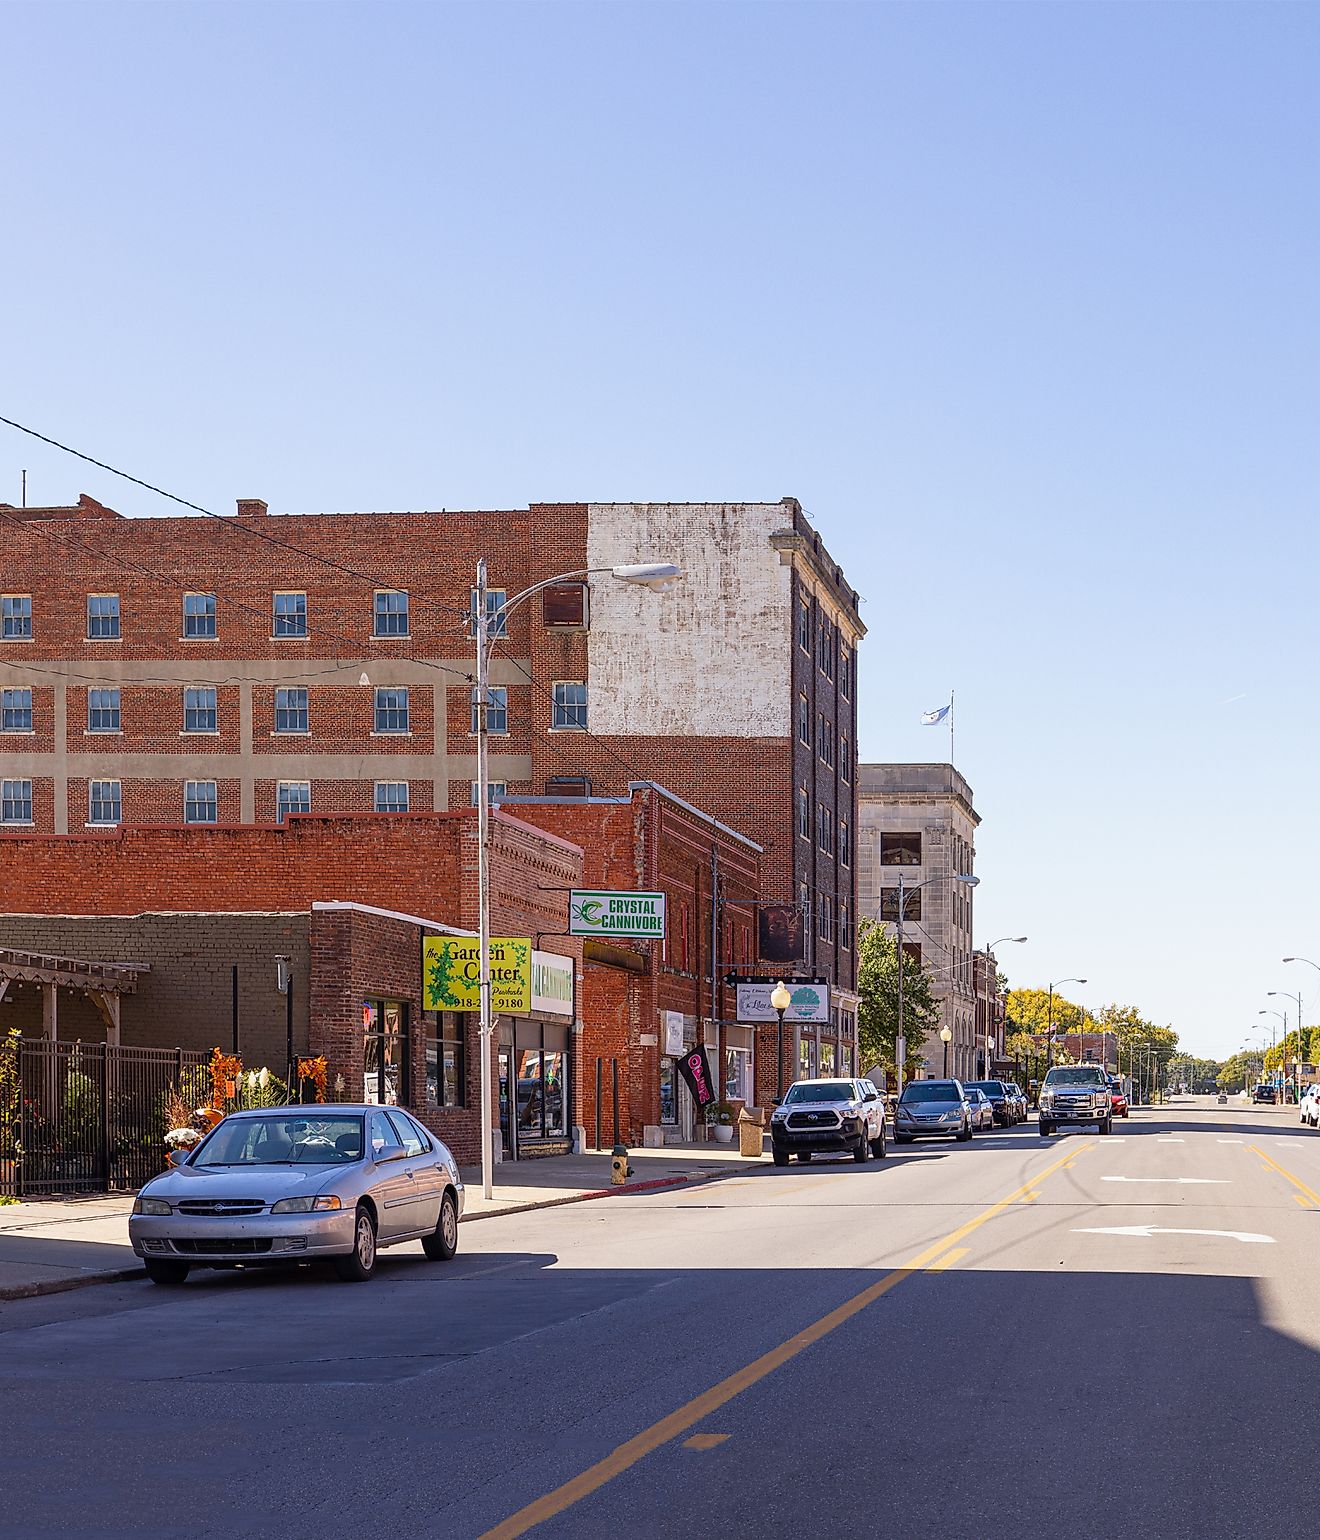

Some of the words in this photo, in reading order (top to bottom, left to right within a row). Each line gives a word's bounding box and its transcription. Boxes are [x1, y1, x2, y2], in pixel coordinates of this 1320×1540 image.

[608, 899, 656, 915] CRYSTAL
[601, 914, 663, 930] CANNIVORE
[426, 947, 438, 959] the
